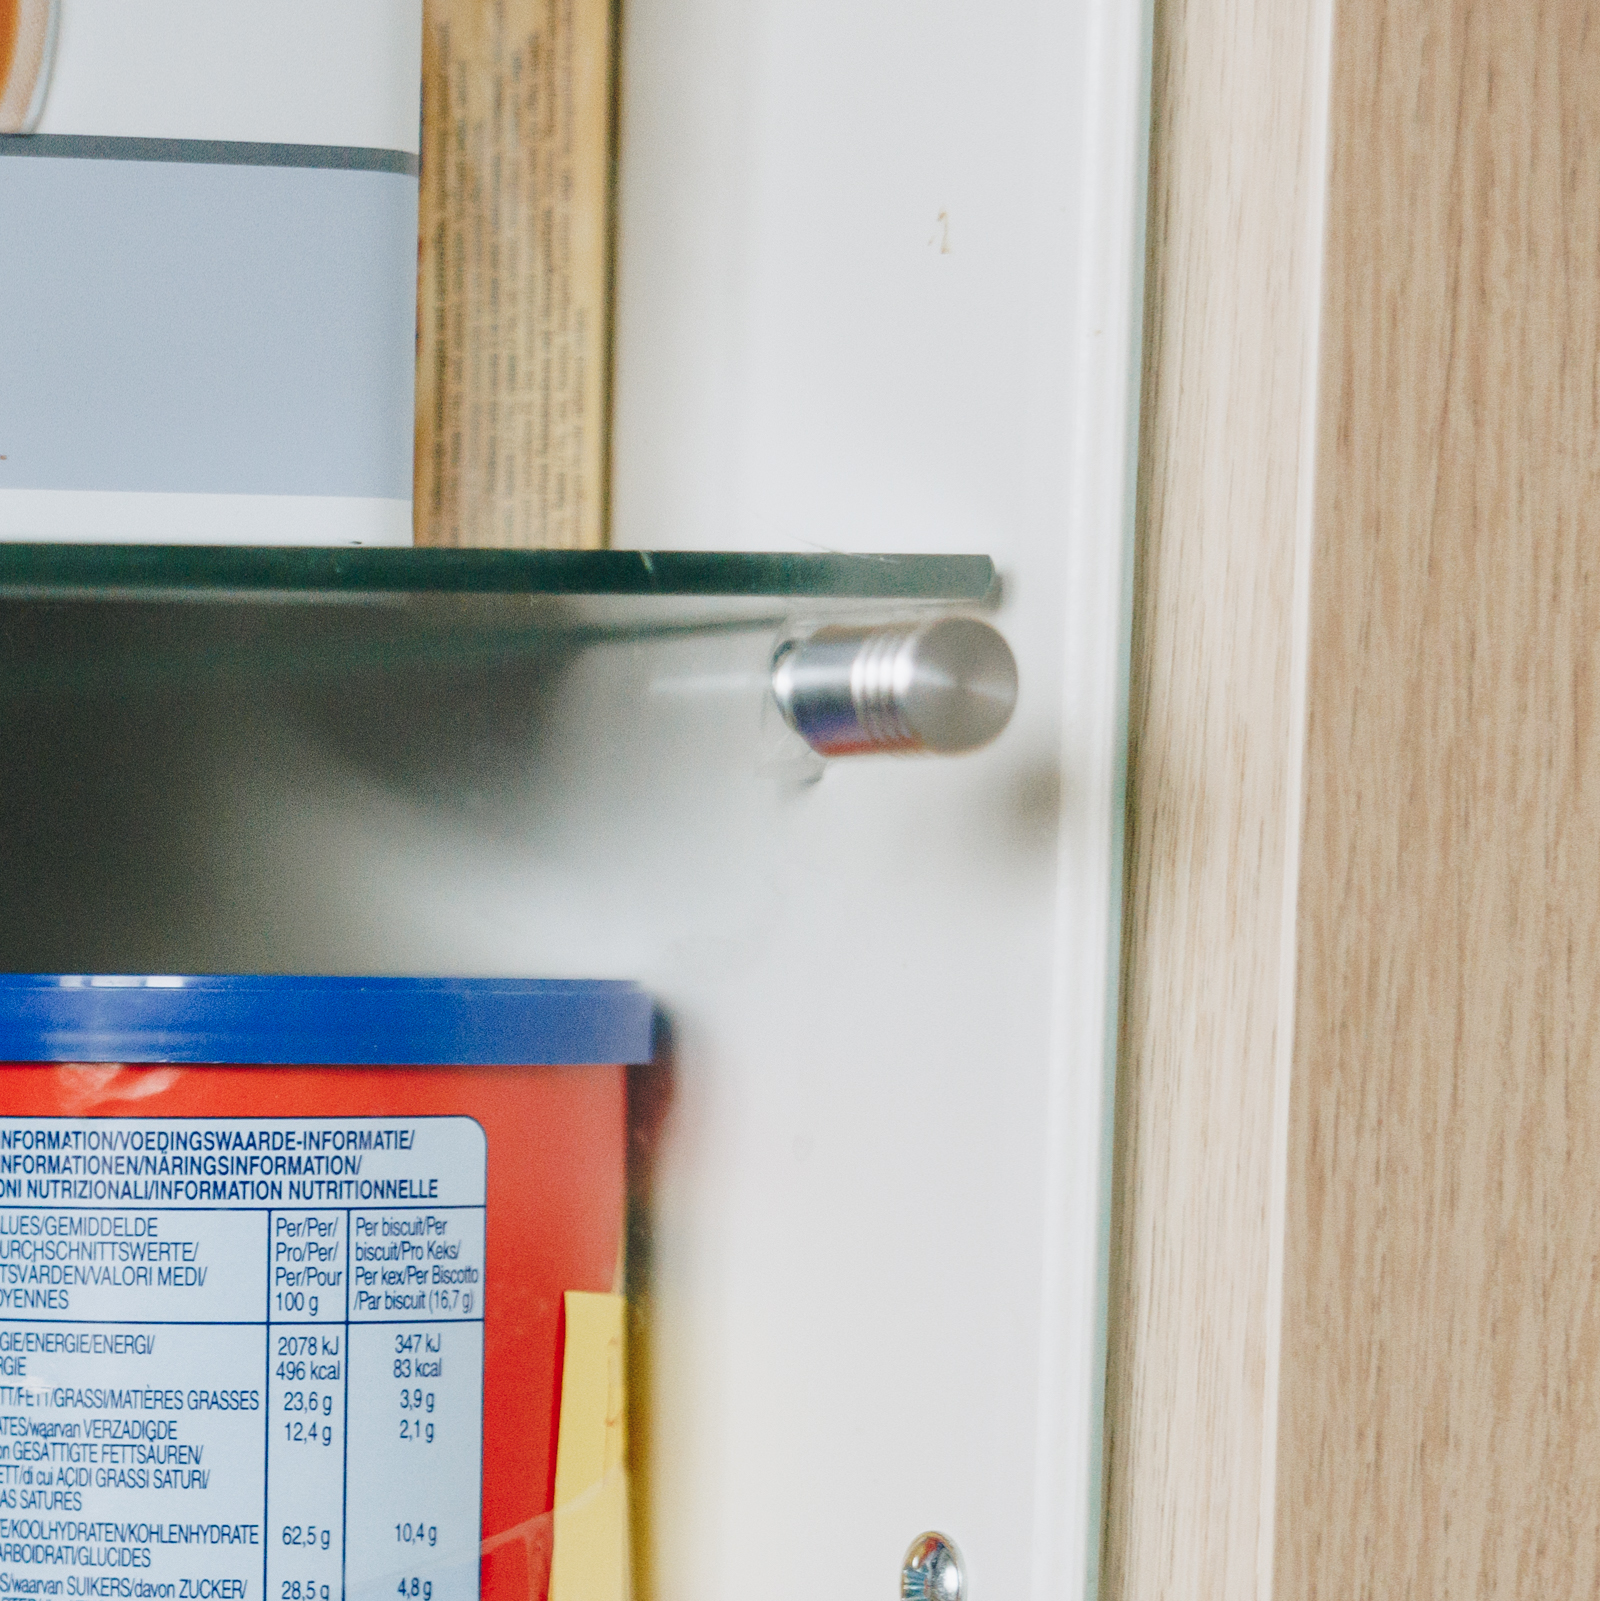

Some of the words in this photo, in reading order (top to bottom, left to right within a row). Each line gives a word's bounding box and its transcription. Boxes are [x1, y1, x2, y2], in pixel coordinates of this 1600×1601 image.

[27, 1179, 282, 1201] NUTRIZIONALI/INFORMATION
[289, 1179, 438, 1200] NUTRITIONNELLE
[276, 1217, 338, 1238] Per/Per/
[355, 1217, 379, 1237] Per
[382, 1216, 448, 1237] biscuit/Per
[276, 1242, 339, 1262] Pro/Per/
[355, 1241, 423, 1262] biscuit/Pro
[157, 1266, 207, 1287] MEDI/
[275, 1266, 343, 1287] Per/Pour
[355, 1266, 378, 1286] Per
[381, 1266, 429, 1286] kex/Per
[275, 1291, 305, 1311] 100
[277, 1336, 318, 1356] 2078
[395, 1334, 422, 1354] 347
[276, 1361, 306, 1380] 496
[310, 1360, 341, 1381] kcal
[187, 1389, 260, 1411] GRASSES
[284, 1391, 318, 1413] 23,6
[83, 1419, 178, 1441] VERZADIGDE
[284, 1422, 318, 1444] 12,4
[96, 1469, 149, 1489] GRASSI
[282, 1526, 317, 1548] 62,5
[395, 1523, 425, 1546] 10,4
[66, 1576, 175, 1599] SUIKERS/davon
[179, 1578, 248, 1600] ZUCKER/
